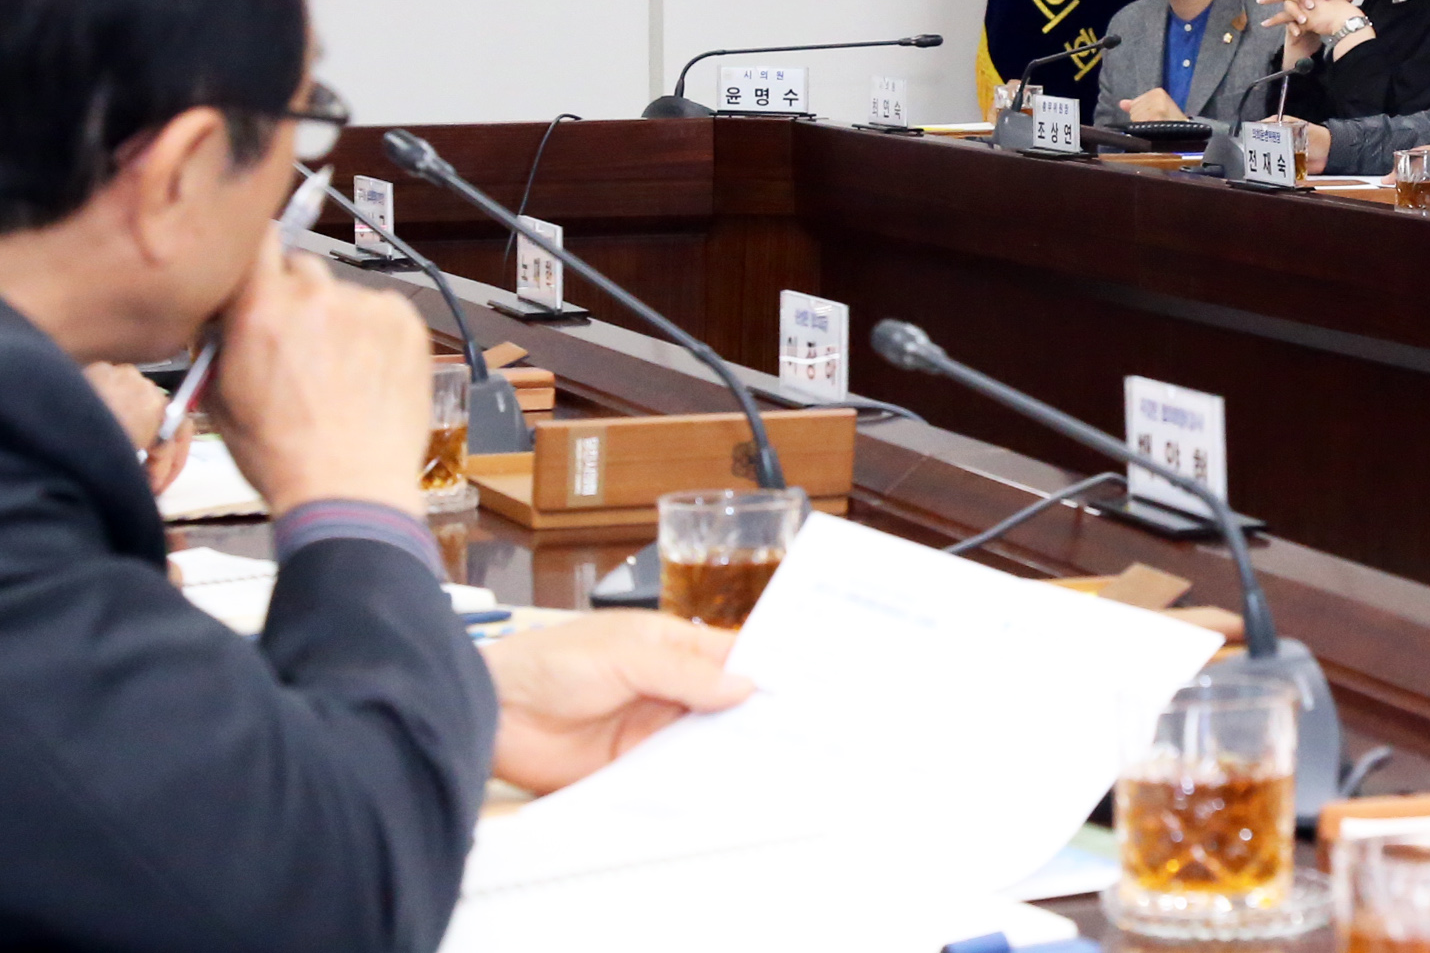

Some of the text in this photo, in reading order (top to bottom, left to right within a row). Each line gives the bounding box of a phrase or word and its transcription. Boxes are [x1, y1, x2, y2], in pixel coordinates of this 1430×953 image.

[744, 70, 784, 80] 시의원
[726, 87, 799, 107] 윤명수
[1038, 121, 1072, 145] 조상연
[1249, 149, 1287, 178] 전재숙
